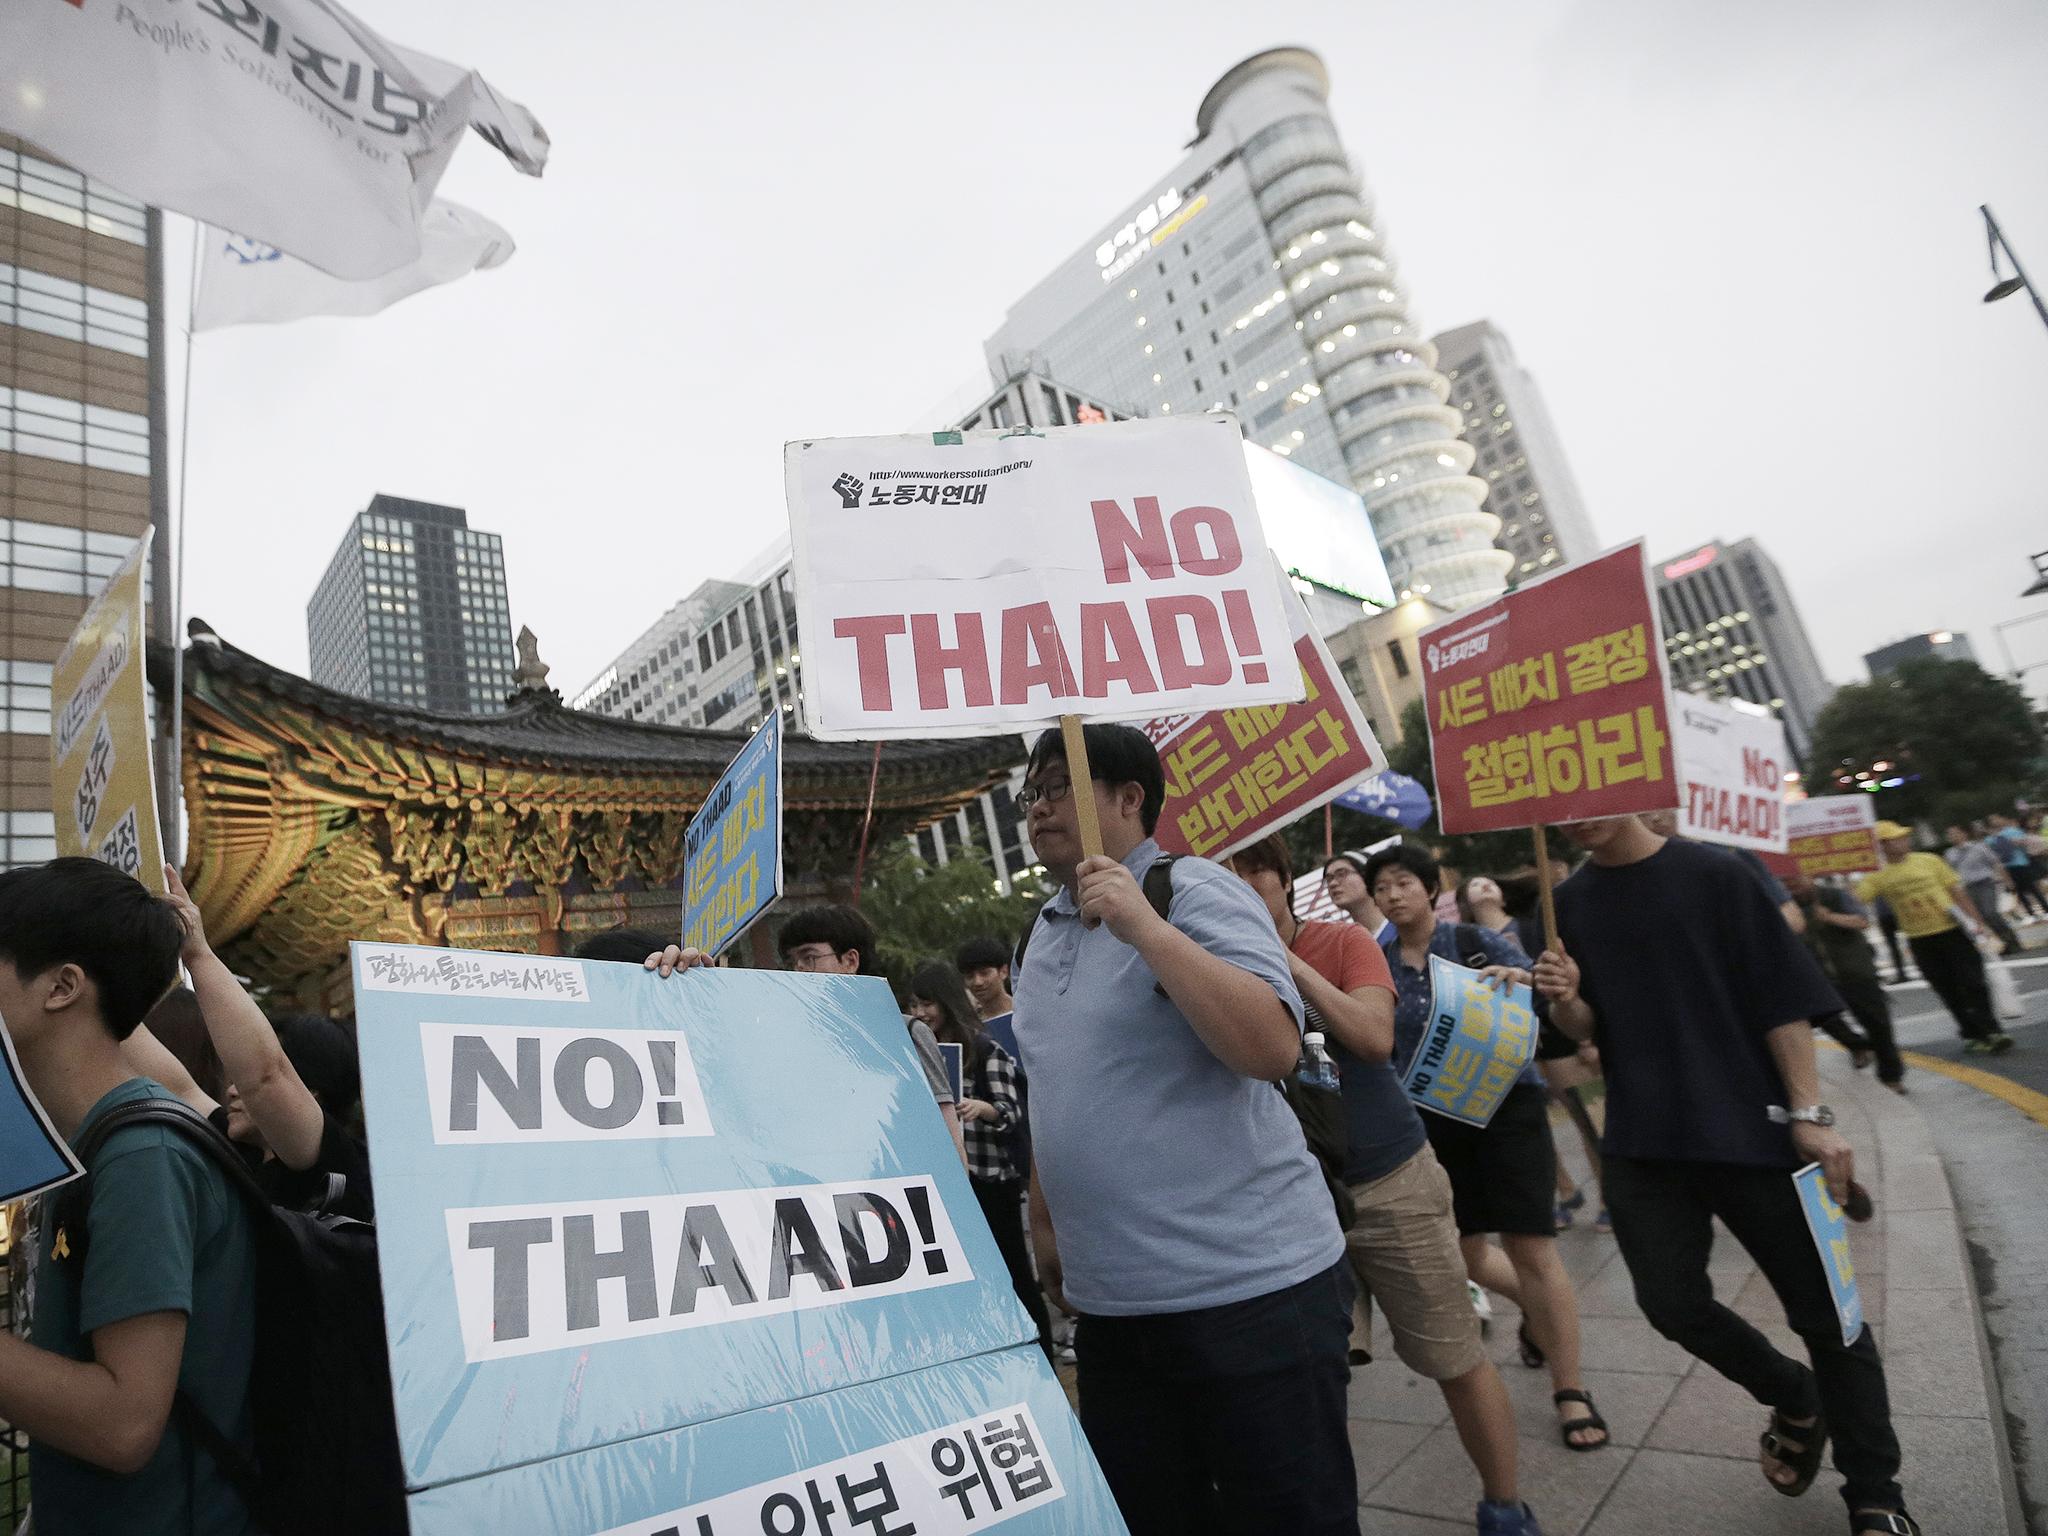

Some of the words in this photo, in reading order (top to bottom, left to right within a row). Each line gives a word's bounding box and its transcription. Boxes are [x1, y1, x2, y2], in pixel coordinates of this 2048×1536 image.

[869, 460, 1033, 480] http://www.workerssolidarity.org/
[833, 589, 1270, 712] THAAD!
[1439, 677, 1488, 731] 사드
[1489, 652, 1560, 714] 배치
[1563, 623, 1650, 695] 결정
[1161, 724, 1230, 814] 사드
[1177, 708, 1350, 856] 반대한다
[1462, 704, 1665, 808] 철회하라
[687, 834, 718, 907] 사드
[723, 773, 766, 868] 배치
[702, 780, 732, 841] THAAD
[1687, 782, 1779, 841] THAAD!
[449, 1035, 684, 1131] NO!
[1408, 1072, 1432, 1096] NO
[1422, 1014, 1456, 1068] THAAD
[1431, 1044, 1483, 1110] 사드
[468, 1185, 949, 1342] THAAD!
[930, 1413, 1053, 1521] 위협
